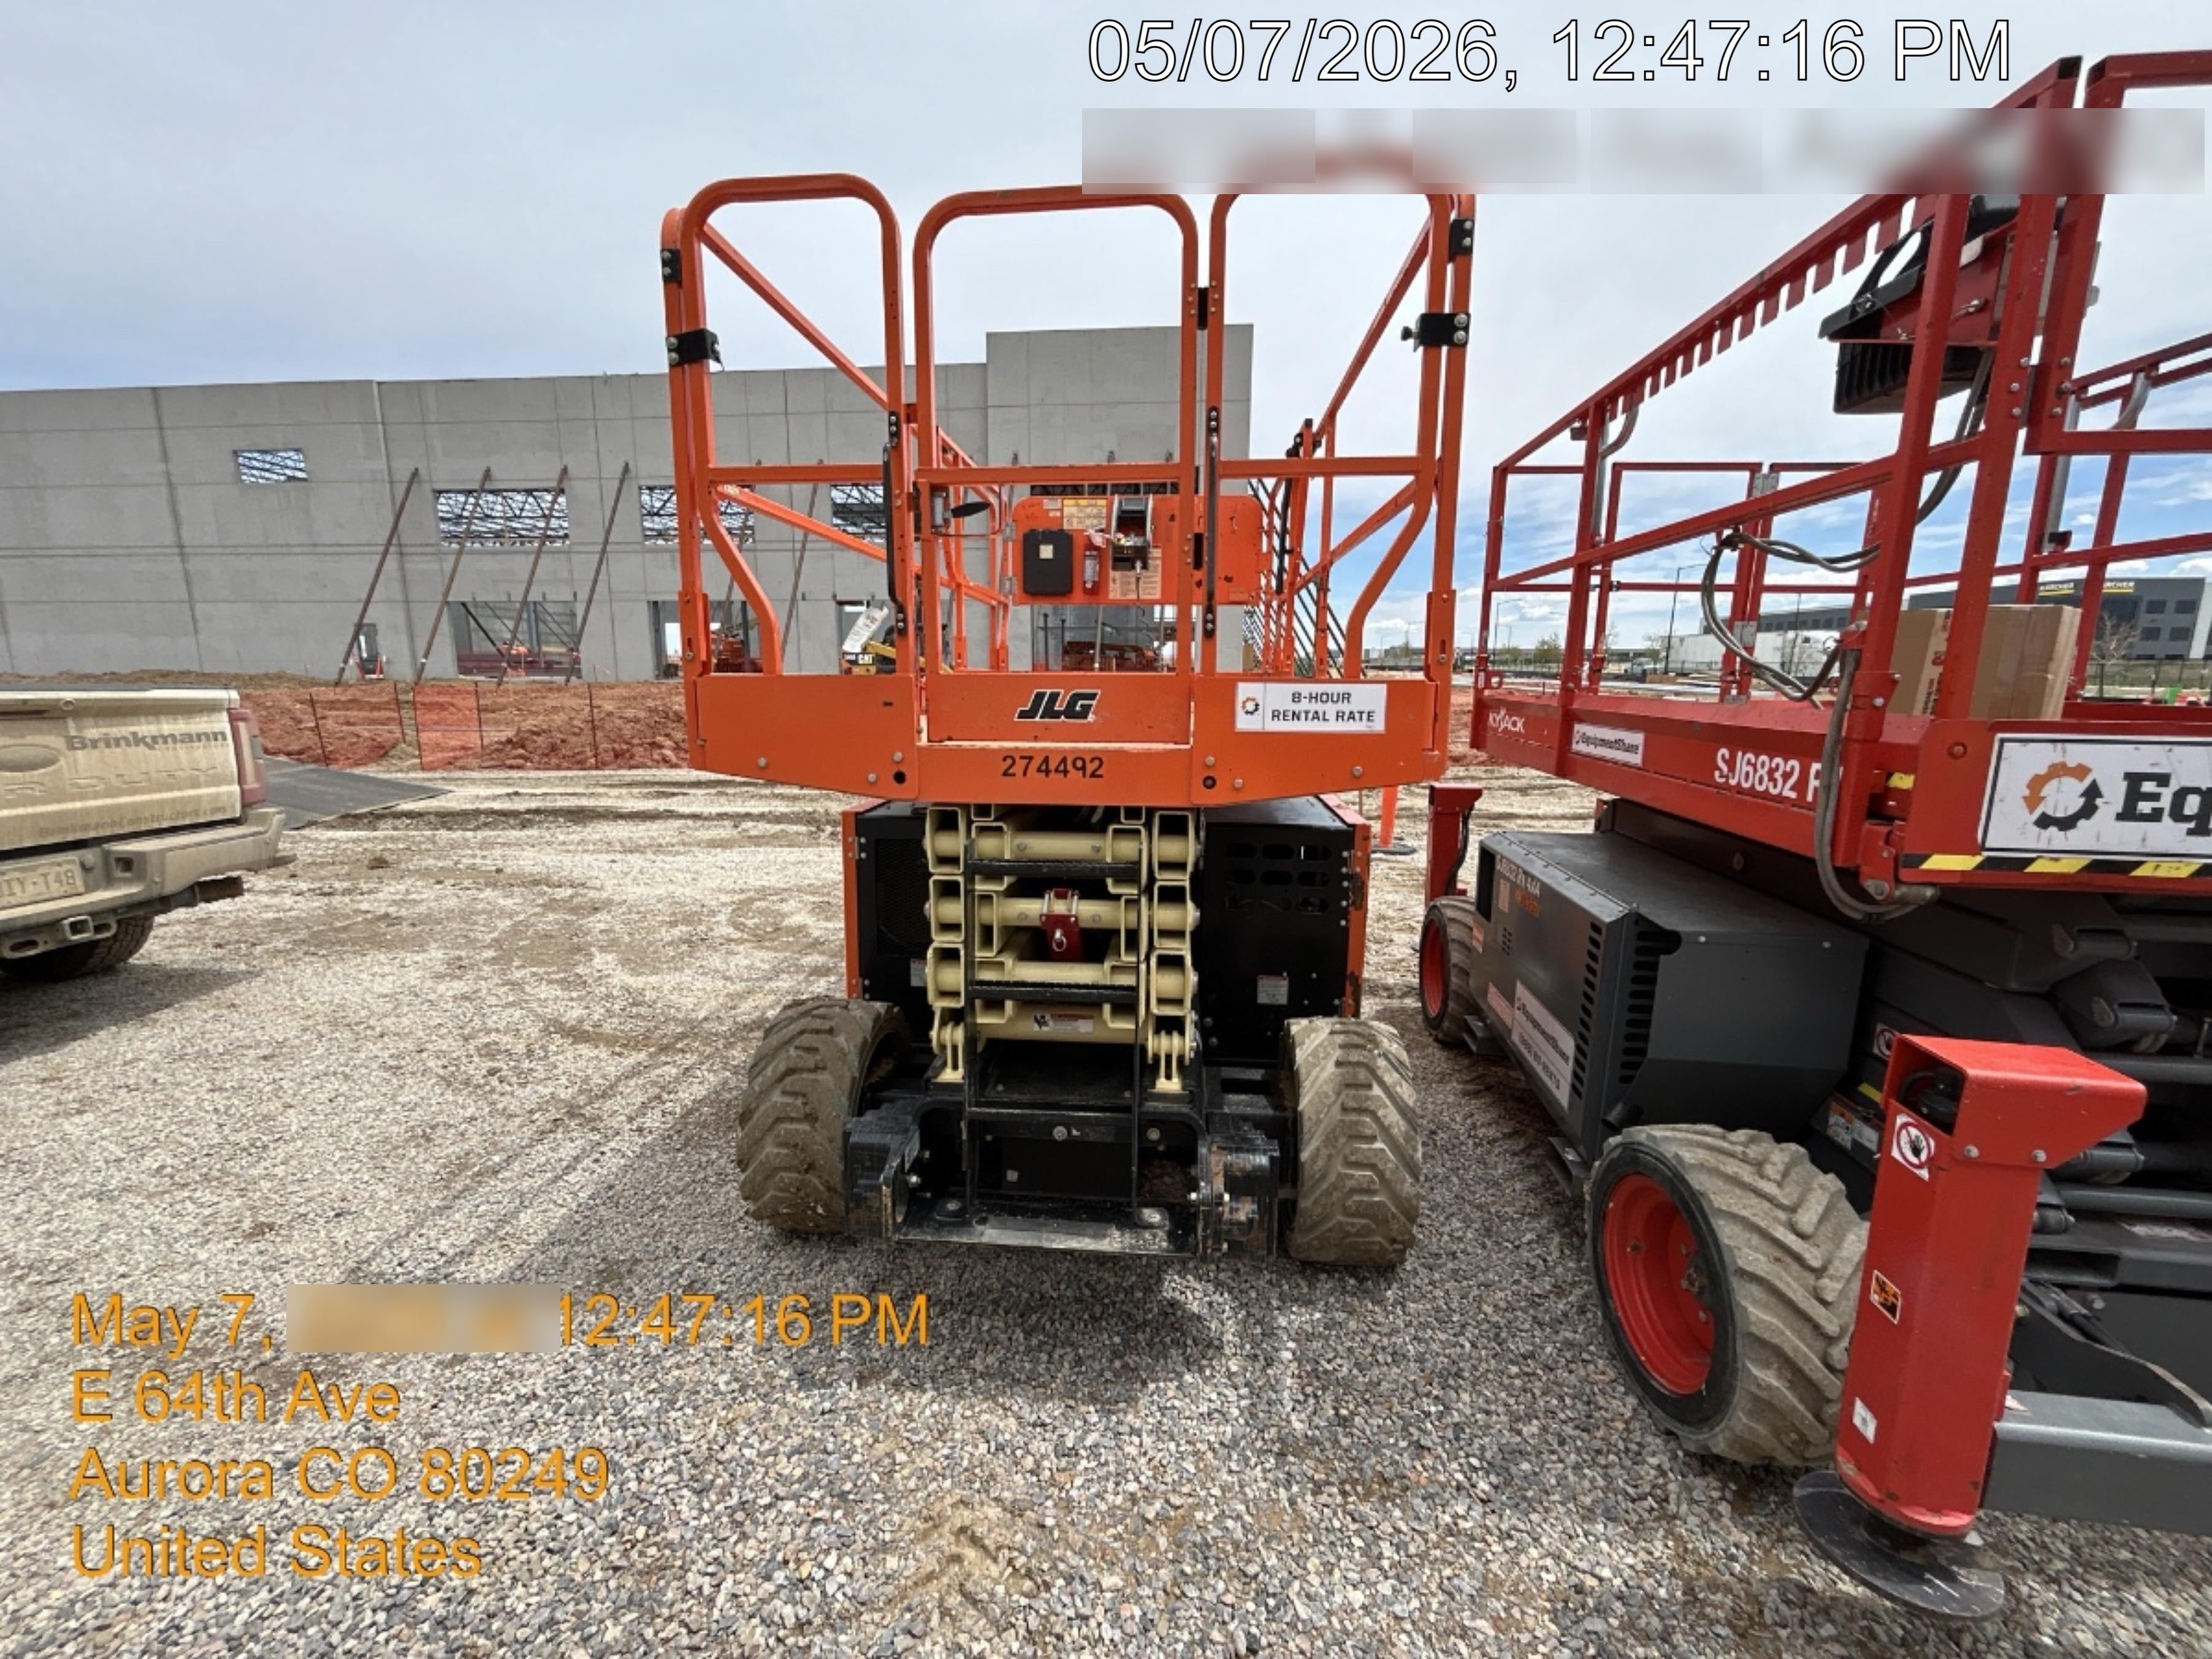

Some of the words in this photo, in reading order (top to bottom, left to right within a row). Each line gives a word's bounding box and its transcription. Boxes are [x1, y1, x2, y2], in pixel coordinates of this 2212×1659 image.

[1014, 689, 1101, 723] JLG
[1292, 691, 1352, 704] 8-HOUR
[1271, 709, 1330, 722] RENTAL
[1336, 710, 1376, 723] RATE
[1488, 706, 1525, 734] KYJACK
[64, 731, 228, 750] Brinkmann
[1002, 755, 1104, 779] 274492
[1714, 748, 1800, 799] SJ6832
